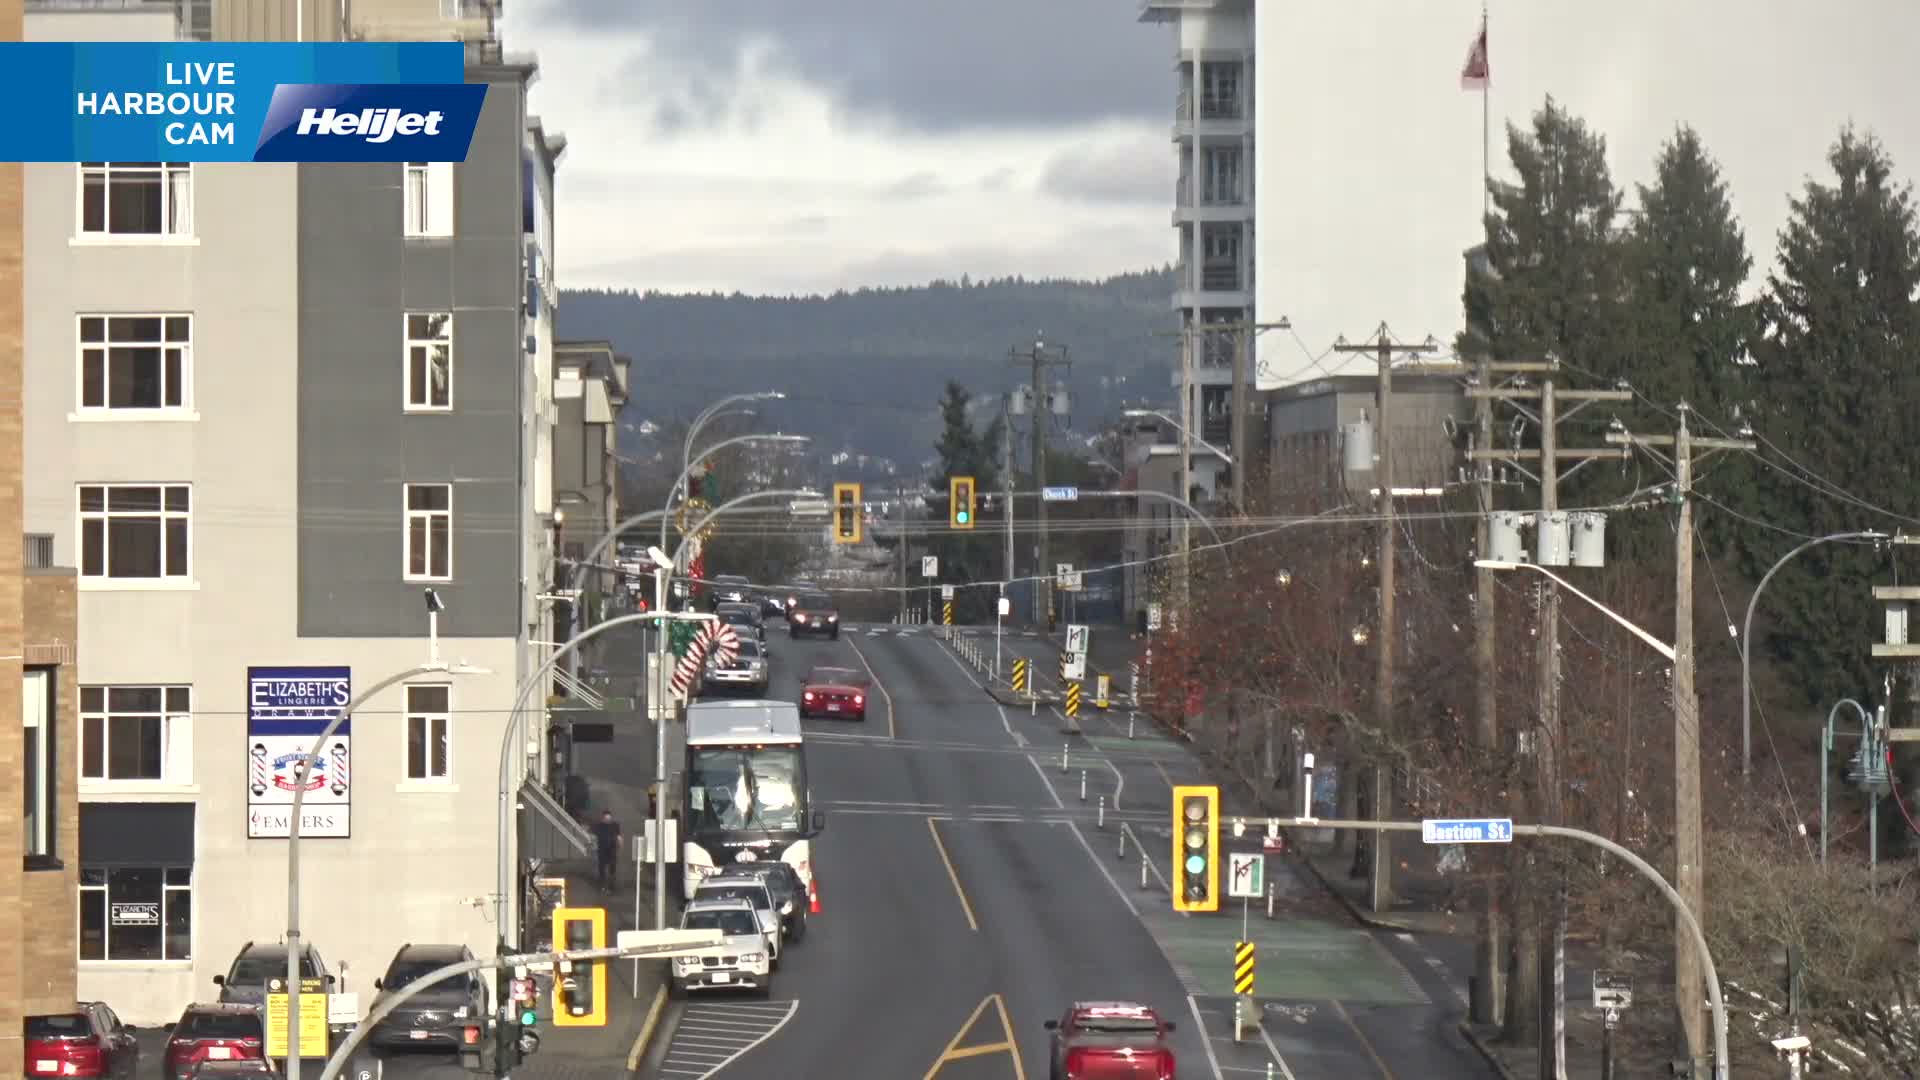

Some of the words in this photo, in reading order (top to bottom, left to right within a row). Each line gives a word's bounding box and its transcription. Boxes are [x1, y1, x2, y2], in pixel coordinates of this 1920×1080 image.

[252, 681, 349, 706] ELIZABETH'S
[278, 697, 326, 705] LINGERIE
[263, 815, 335, 829] EMERS
[1424, 823, 1482, 841] Bastion
[1487, 822, 1510, 840] St.
